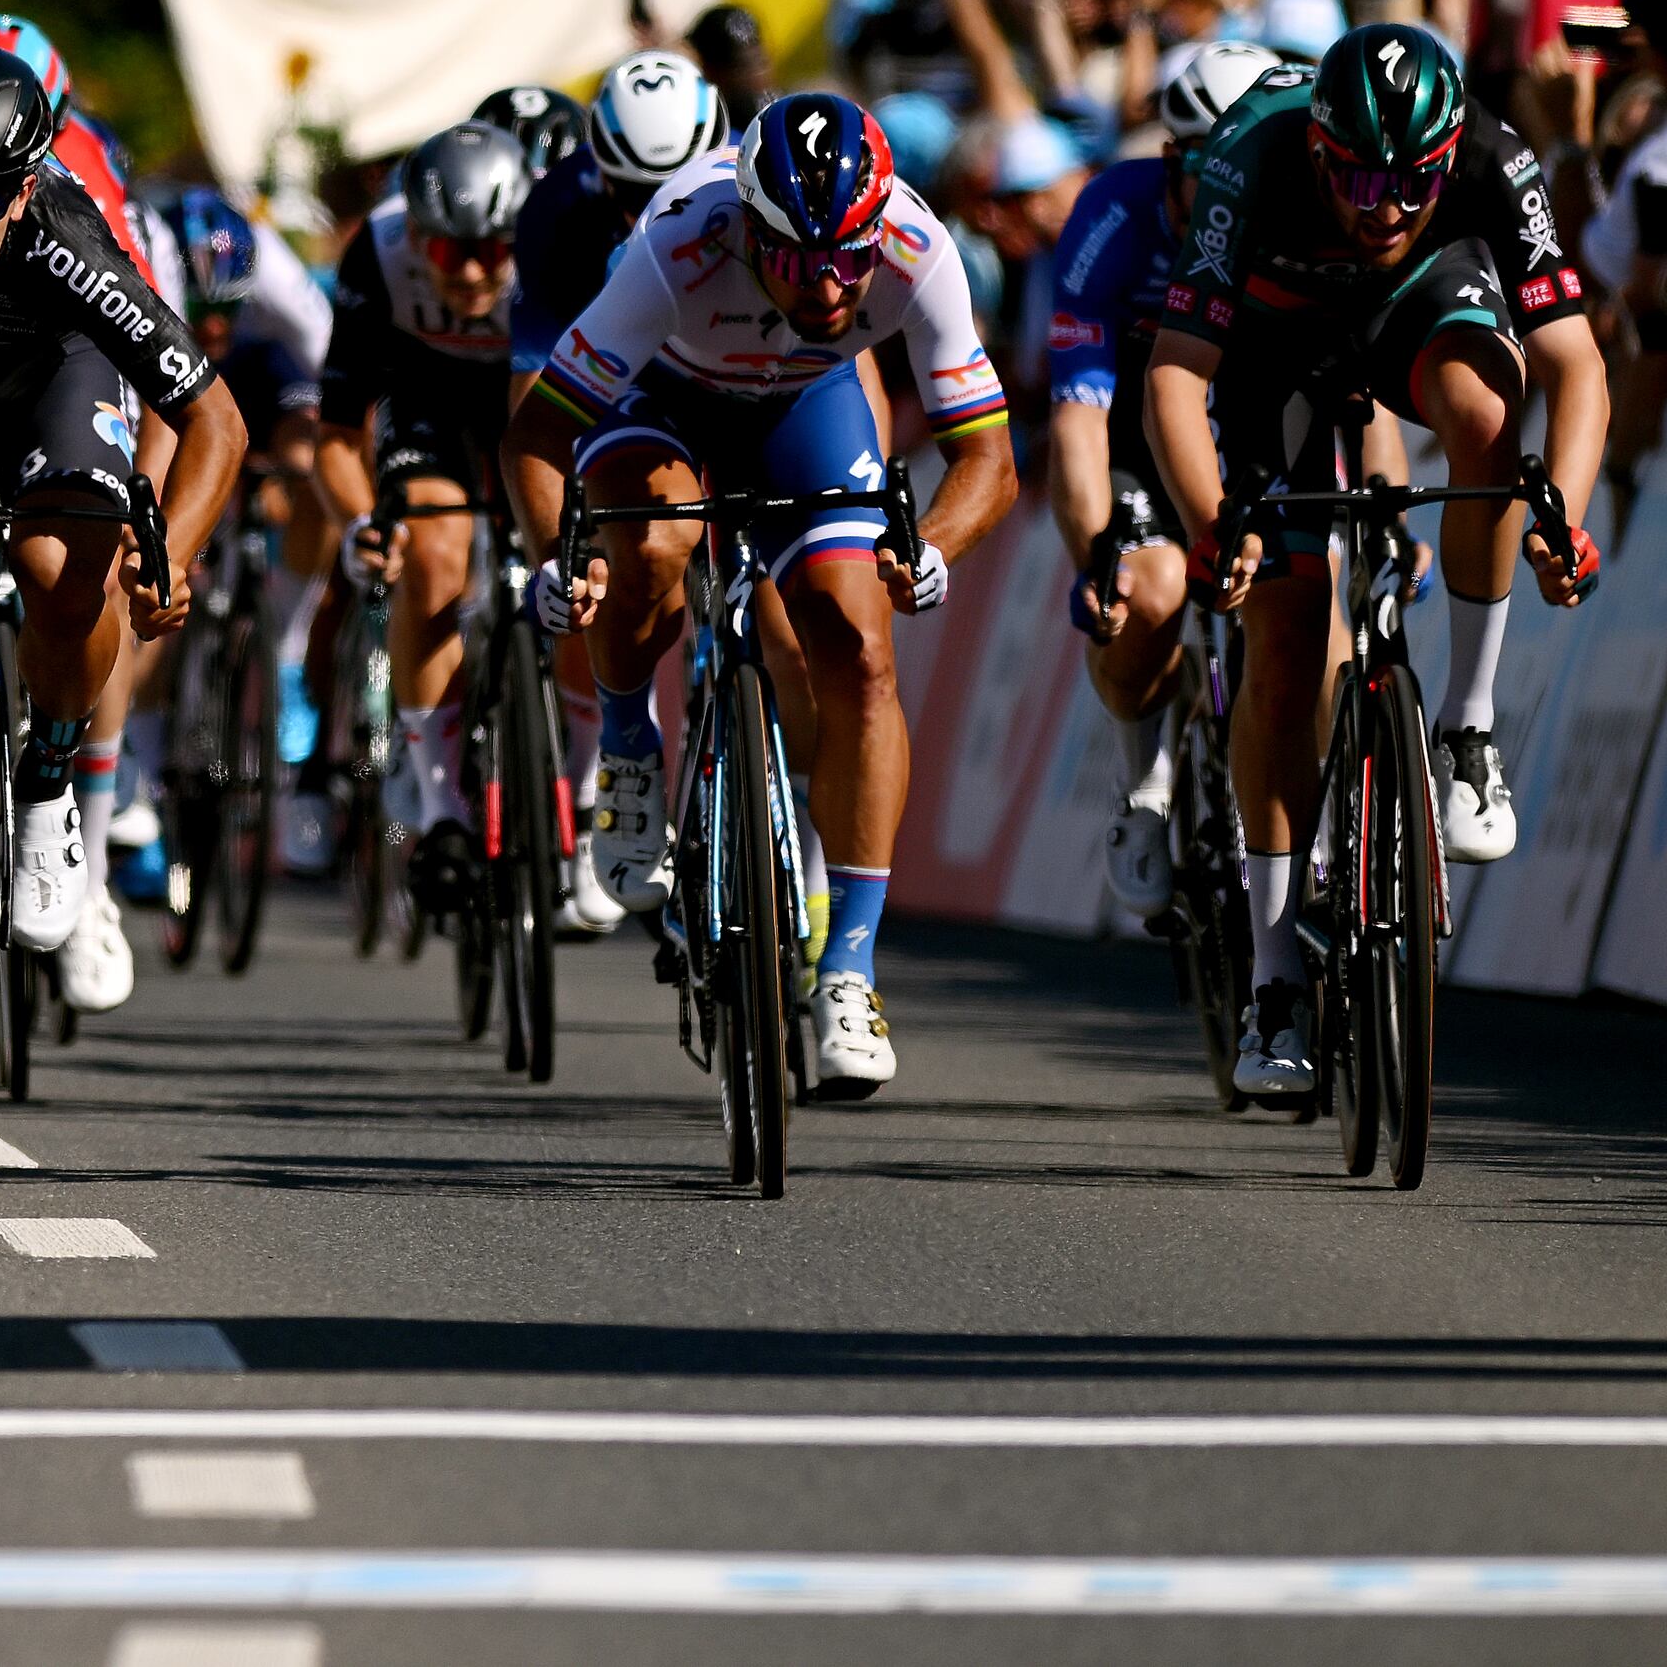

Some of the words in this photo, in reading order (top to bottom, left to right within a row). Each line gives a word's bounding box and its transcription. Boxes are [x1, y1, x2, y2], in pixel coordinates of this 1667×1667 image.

[4, 113, 23, 149] youfone
[25, 229, 156, 343] youfone
[1169, 287, 1192, 301] ÖTZ
[1521, 282, 1550, 300] ÖTZ
[1167, 299, 1190, 311] TAL
[1524, 294, 1552, 308] TAL
